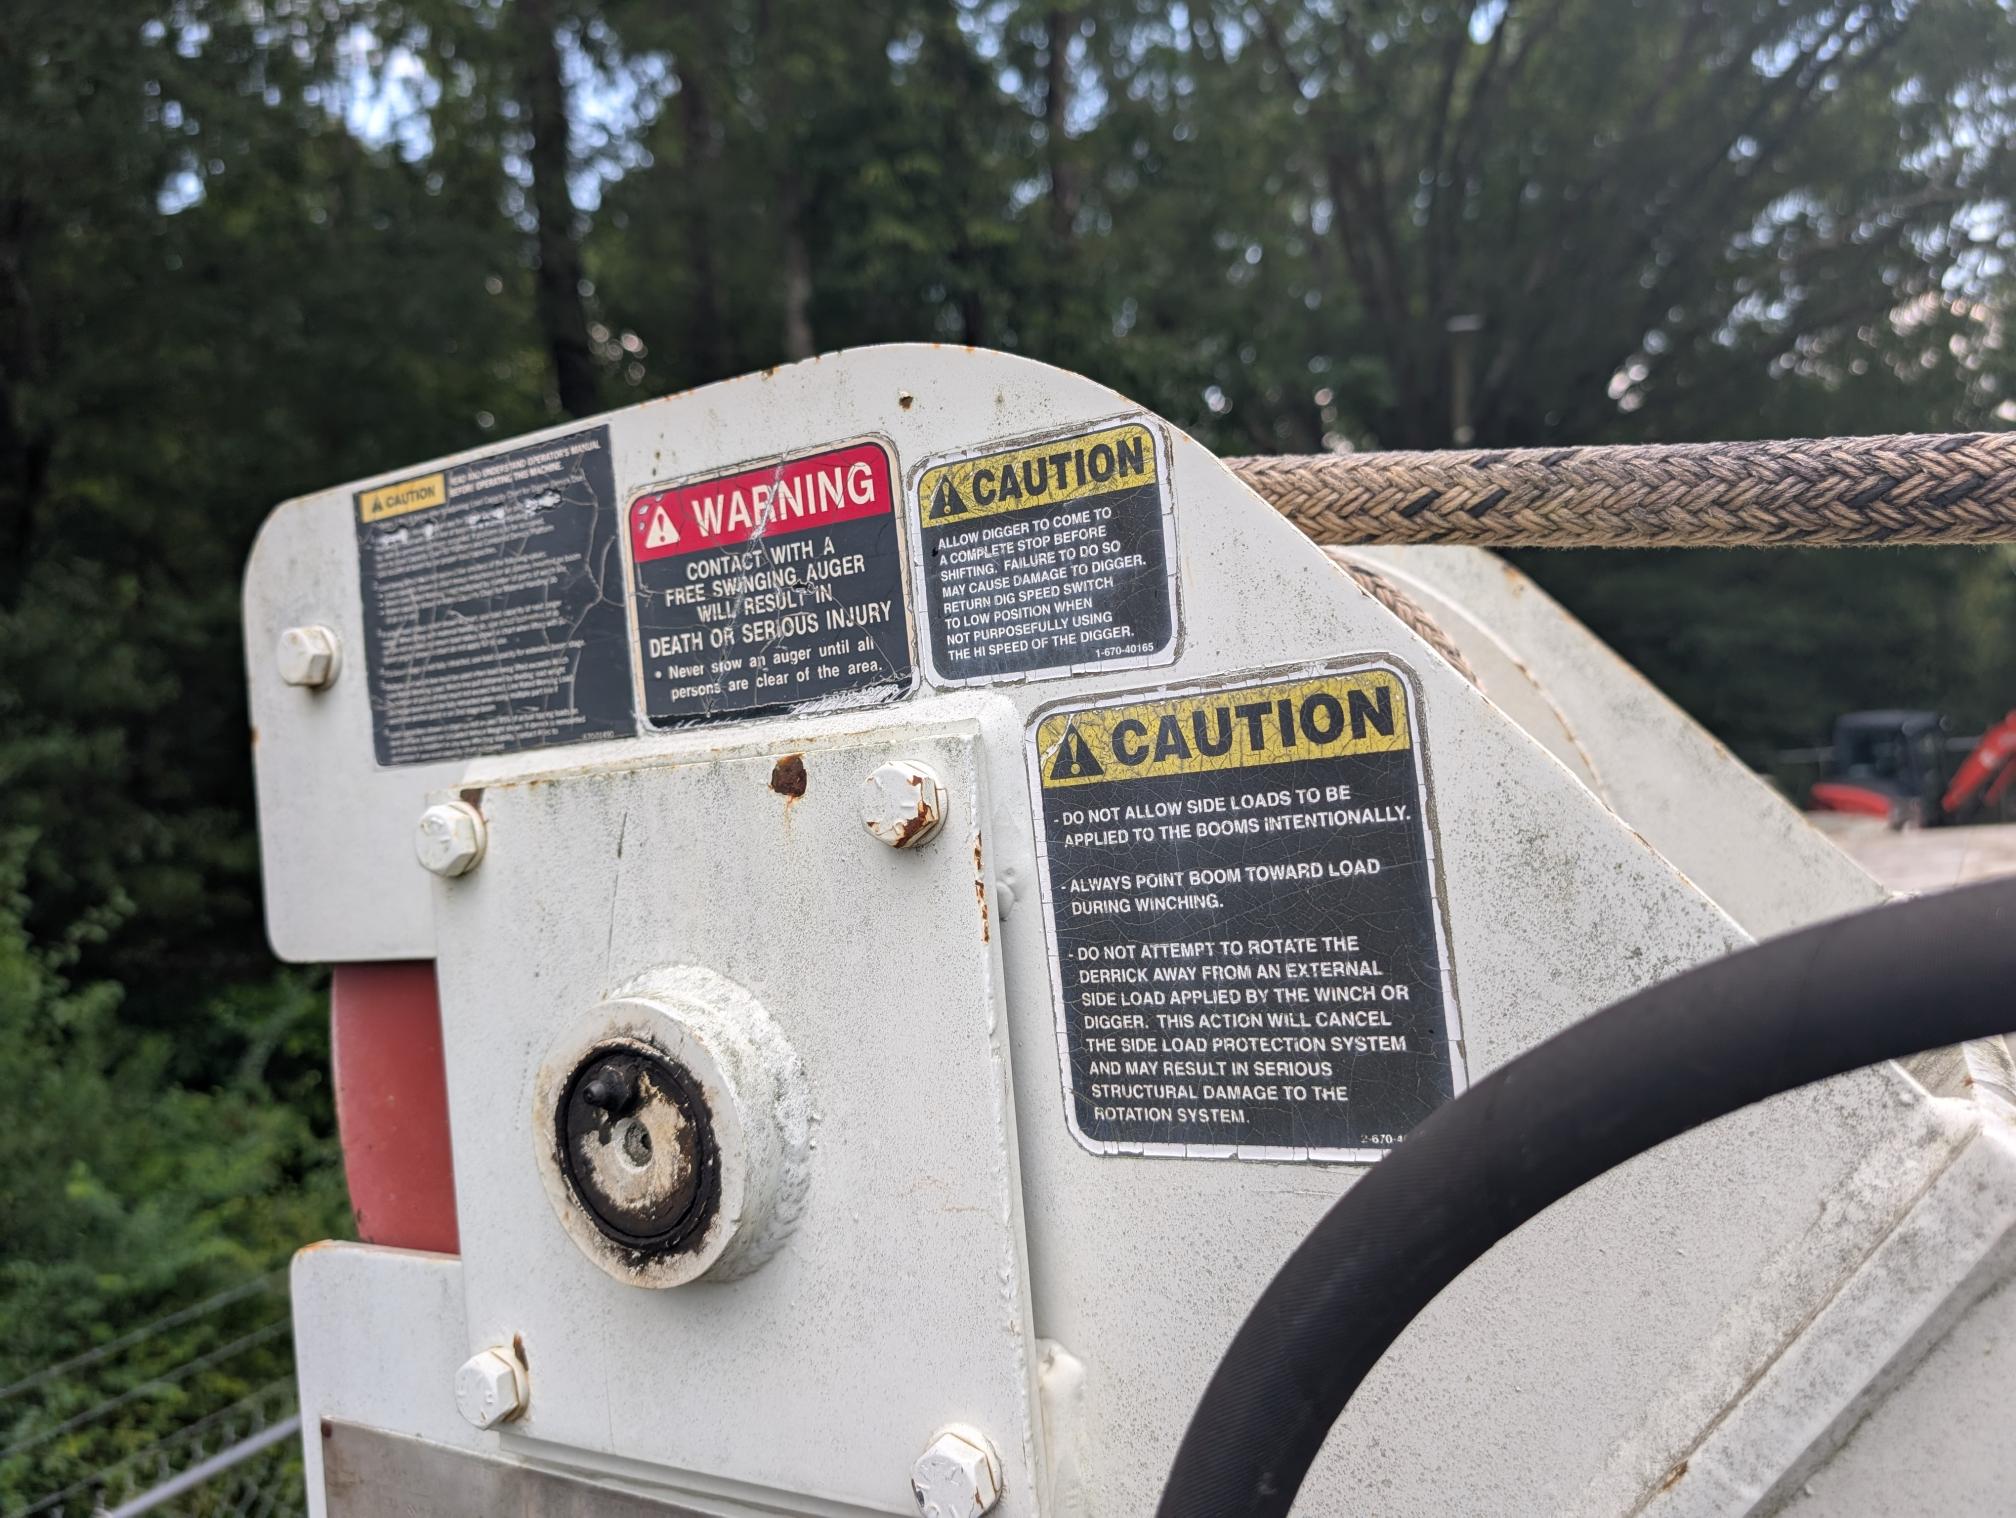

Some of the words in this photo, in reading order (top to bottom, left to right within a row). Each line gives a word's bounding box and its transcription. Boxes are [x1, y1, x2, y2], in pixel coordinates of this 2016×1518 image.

[972, 436, 1145, 505] CAUTION
[386, 487, 436, 508] CAUTION
[692, 461, 875, 537] WARNING
[937, 531, 979, 549] ALLOW
[982, 522, 1029, 541] DIGGER
[1032, 518, 1049, 532] TO
[1052, 510, 1090, 528] COME
[1095, 507, 1111, 520] TO
[939, 554, 947, 565] A
[949, 542, 1014, 564] COMPLETE
[1017, 535, 1050, 551] STOP
[1054, 525, 1106, 545] BEFORE
[686, 551, 763, 579] CONTACT
[770, 541, 813, 564] WITH
[822, 536, 834, 554] A
[940, 562, 997, 582] SHIFTING.
[1003, 552, 1055, 571] FAILURE
[1058, 548, 1075, 561] TO
[1079, 544, 1098, 558] DO
[1102, 540, 1120, 554] SO
[942, 584, 965, 598] MAY
[968, 577, 1010, 594] CAUSE
[1013, 567, 1067, 586] DAMAGE
[1070, 563, 1088, 577] TO
[1091, 553, 1146, 573] DIGGER.
[665, 584, 705, 605] FREE
[712, 568, 797, 597] SWINGING
[805, 556, 865, 580] AUGER
[943, 596, 990, 614] RETURN
[993, 592, 1015, 606] DIG
[1018, 585, 1059, 602] SPEED
[1063, 576, 1113, 594] SWITCH
[696, 600, 736, 623] WILL
[743, 588, 804, 614] RESULT
[814, 583, 832, 603] IN
[944, 617, 960, 629] TO
[963, 613, 990, 626] LOW
[993, 603, 1050, 622] POSITION
[1053, 597, 1092, 613] WHEN
[649, 631, 703, 657] DEATH
[709, 626, 734, 648] OR
[741, 613, 818, 642] SERIOUS
[826, 601, 893, 629] INJURY
[947, 632, 969, 645] NOT
[973, 617, 1068, 641] PURPOSEFULLY
[1071, 611, 1112, 627] USING
[948, 648, 970, 661] THE
[973, 646, 985, 657] HI
[988, 639, 1028, 655] SPEED
[1031, 636, 1048, 649] OF
[1051, 632, 1076, 646] THE
[1080, 625, 1133, 643] DIGGER.
[668, 661, 704, 679] Never
[749, 653, 765, 667] an
[773, 645, 811, 666] auger
[819, 640, 849, 657] until
[857, 636, 874, 651] all
[1095, 642, 1154, 658] 1-670-40165
[671, 681, 720, 699] persons
[728, 677, 748, 691] are
[756, 670, 788, 687] clear
[796, 666, 810, 681] of
[817, 662, 839, 678] the
[847, 659, 881, 674] area.
[1111, 686, 1394, 766] CAUTION
[1062, 810, 1083, 825] DO
[1087, 807, 1119, 822] NOT
[1124, 801, 1183, 819] ALLOW
[1187, 797, 1226, 813] SIDE
[1230, 791, 1291, 809] LOADS
[1296, 788, 1321, 803] TO
[1325, 785, 1351, 801] BE
[1064, 830, 1128, 848] APPLIED
[1132, 827, 1155, 842] TO
[1159, 824, 1192, 840] THE
[1196, 818, 1260, 837] BOOMS
[1264, 805, 1411, 832] INTENTIONALLY.
[1069, 876, 1131, 893] ALWAYS
[1135, 871, 1184, 889] POINT
[1188, 868, 1242, 885] BOOM
[1246, 862, 1323, 882] TOWARD
[1327, 858, 1381, 876] LOAD
[1071, 899, 1131, 915] DURING
[1135, 893, 1224, 912] WINCHING.
[1077, 947, 1099, 961] DO
[1103, 945, 1135, 960] NOT
[1139, 941, 1216, 959] ATTEMPT
[1220, 941, 1244, 955] TO
[1247, 936, 1317, 955] ROTATE
[1321, 934, 1359, 952] THE
[1079, 968, 1148, 983] DERRICK
[1151, 966, 1197, 981] AWAY
[1201, 965, 1252, 980] FROM
[1255, 963, 1280, 978] AN
[1286, 960, 1383, 977] EXTERNAL
[1081, 992, 1116, 1006] SIDE
[1120, 991, 1165, 1006] LOAD
[1169, 989, 1241, 1005] APPLIED
[1245, 989, 1269, 1003] BY
[1273, 987, 1309, 1003] THE
[1313, 986, 1376, 1002] WINCH
[1380, 985, 1410, 1001] OR
[1084, 1015, 1148, 1029] DIGGER.
[1156, 1013, 1194, 1028] THIS
[1197, 1013, 1263, 1028] ACTION
[1266, 1011, 1310, 1026] WILL
[1315, 1010, 1392, 1027] CANCEL
[1085, 1038, 1116, 1051] THE
[1120, 1038, 1157, 1051] SIDE
[1161, 1037, 1207, 1051] LOAD
[1211, 1036, 1326, 1051] PROTECTION
[1330, 1035, 1406, 1051] SYSTEM
[1088, 1062, 1121, 1075] AND
[1124, 1061, 1157, 1075] MAY
[1162, 1062, 1227, 1075] RESULT
[1231, 1061, 1249, 1075] IN
[1253, 1061, 1333, 1076] SERIOUS
[1091, 1085, 1197, 1099] STRUCTURAL
[1202, 1085, 1277, 1100] DAMAGE
[1282, 1085, 1307, 1100] TO
[1311, 1085, 1349, 1101] THE
[1094, 1107, 1172, 1121] ROTATION
[1177, 1108, 1249, 1123] SYSTEM.
